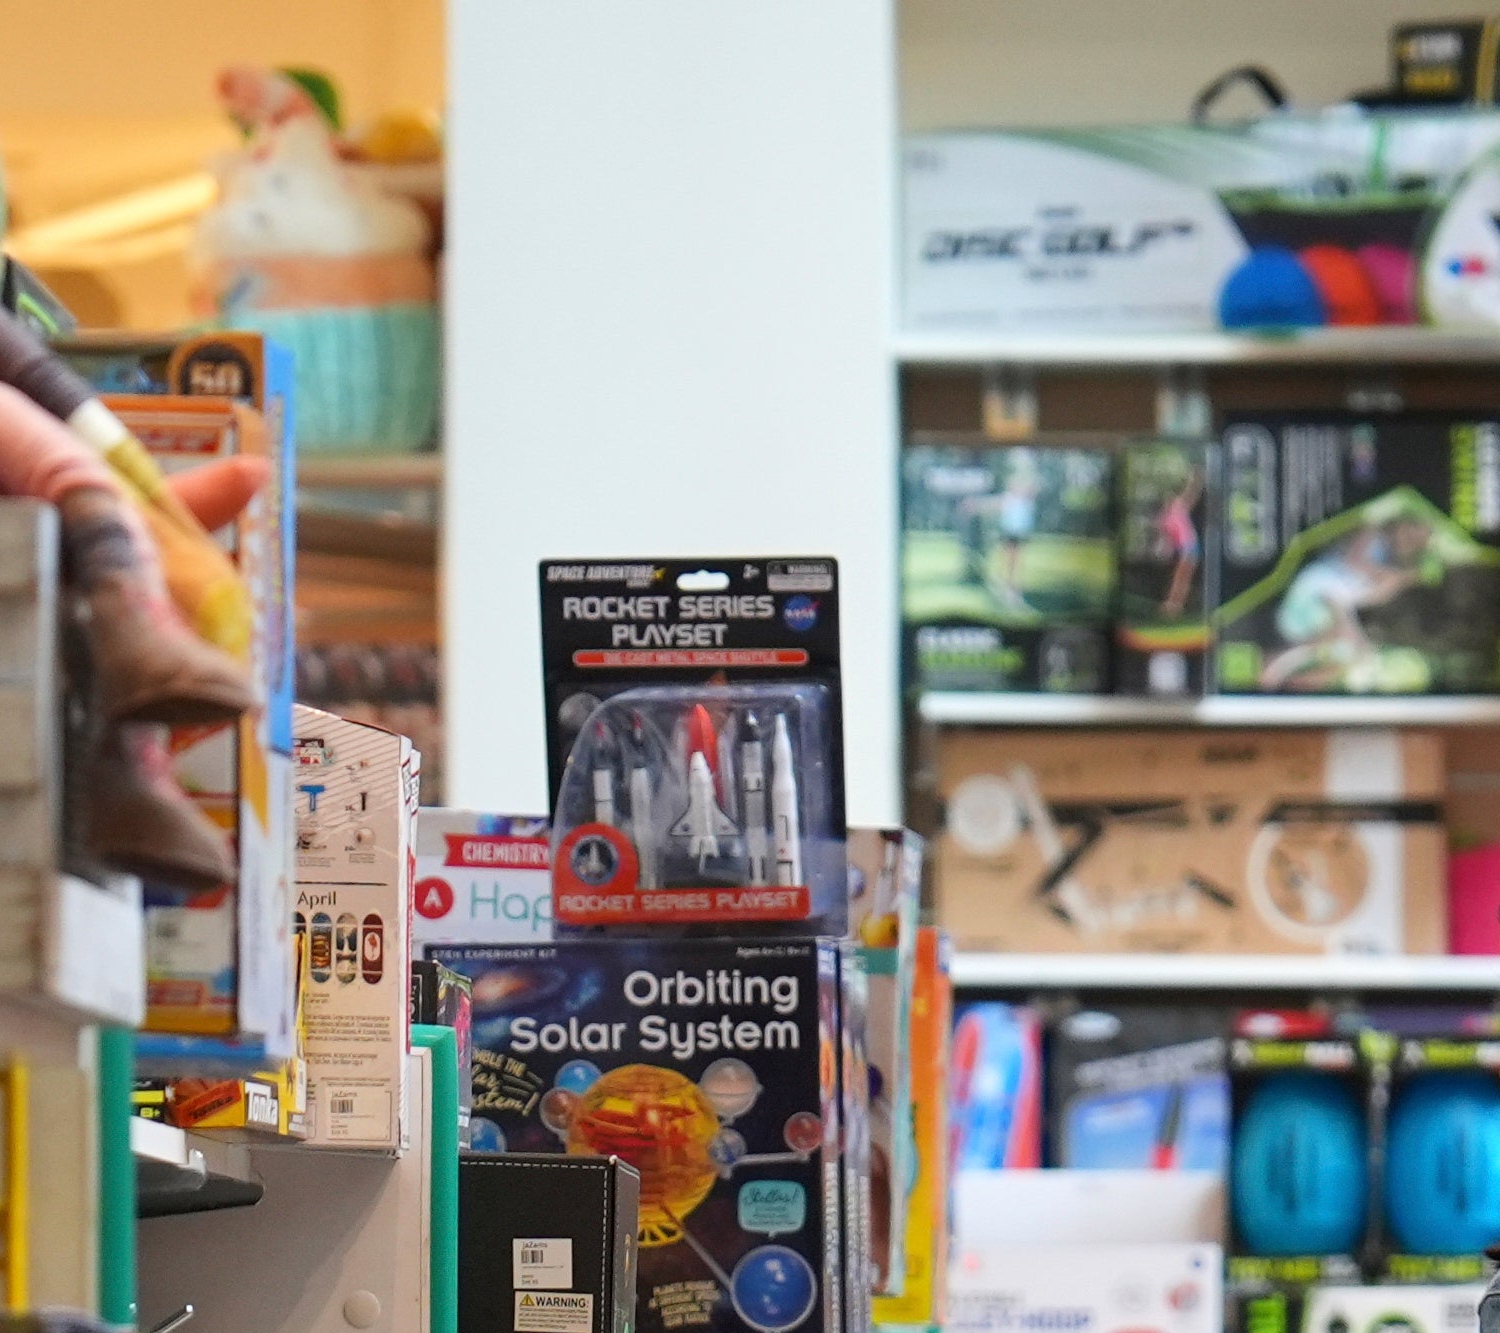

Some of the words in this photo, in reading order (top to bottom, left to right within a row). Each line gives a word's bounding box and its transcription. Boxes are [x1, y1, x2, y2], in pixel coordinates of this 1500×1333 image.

[562, 595, 670, 620] ROCKET
[678, 595, 775, 619] SERIES
[611, 623, 729, 647] PLAYSET
[297, 891, 337, 908] April
[559, 893, 634, 911] ROCKET
[642, 892, 710, 910] SERIES
[716, 890, 799, 909] PLAYSET
[623, 969, 799, 1014] Orbiting
[510, 1014, 626, 1053] Solar
[639, 1014, 799, 1060] System
[244, 1081, 279, 1126] Tonka
[535, 1296, 590, 1309] WARNING:
